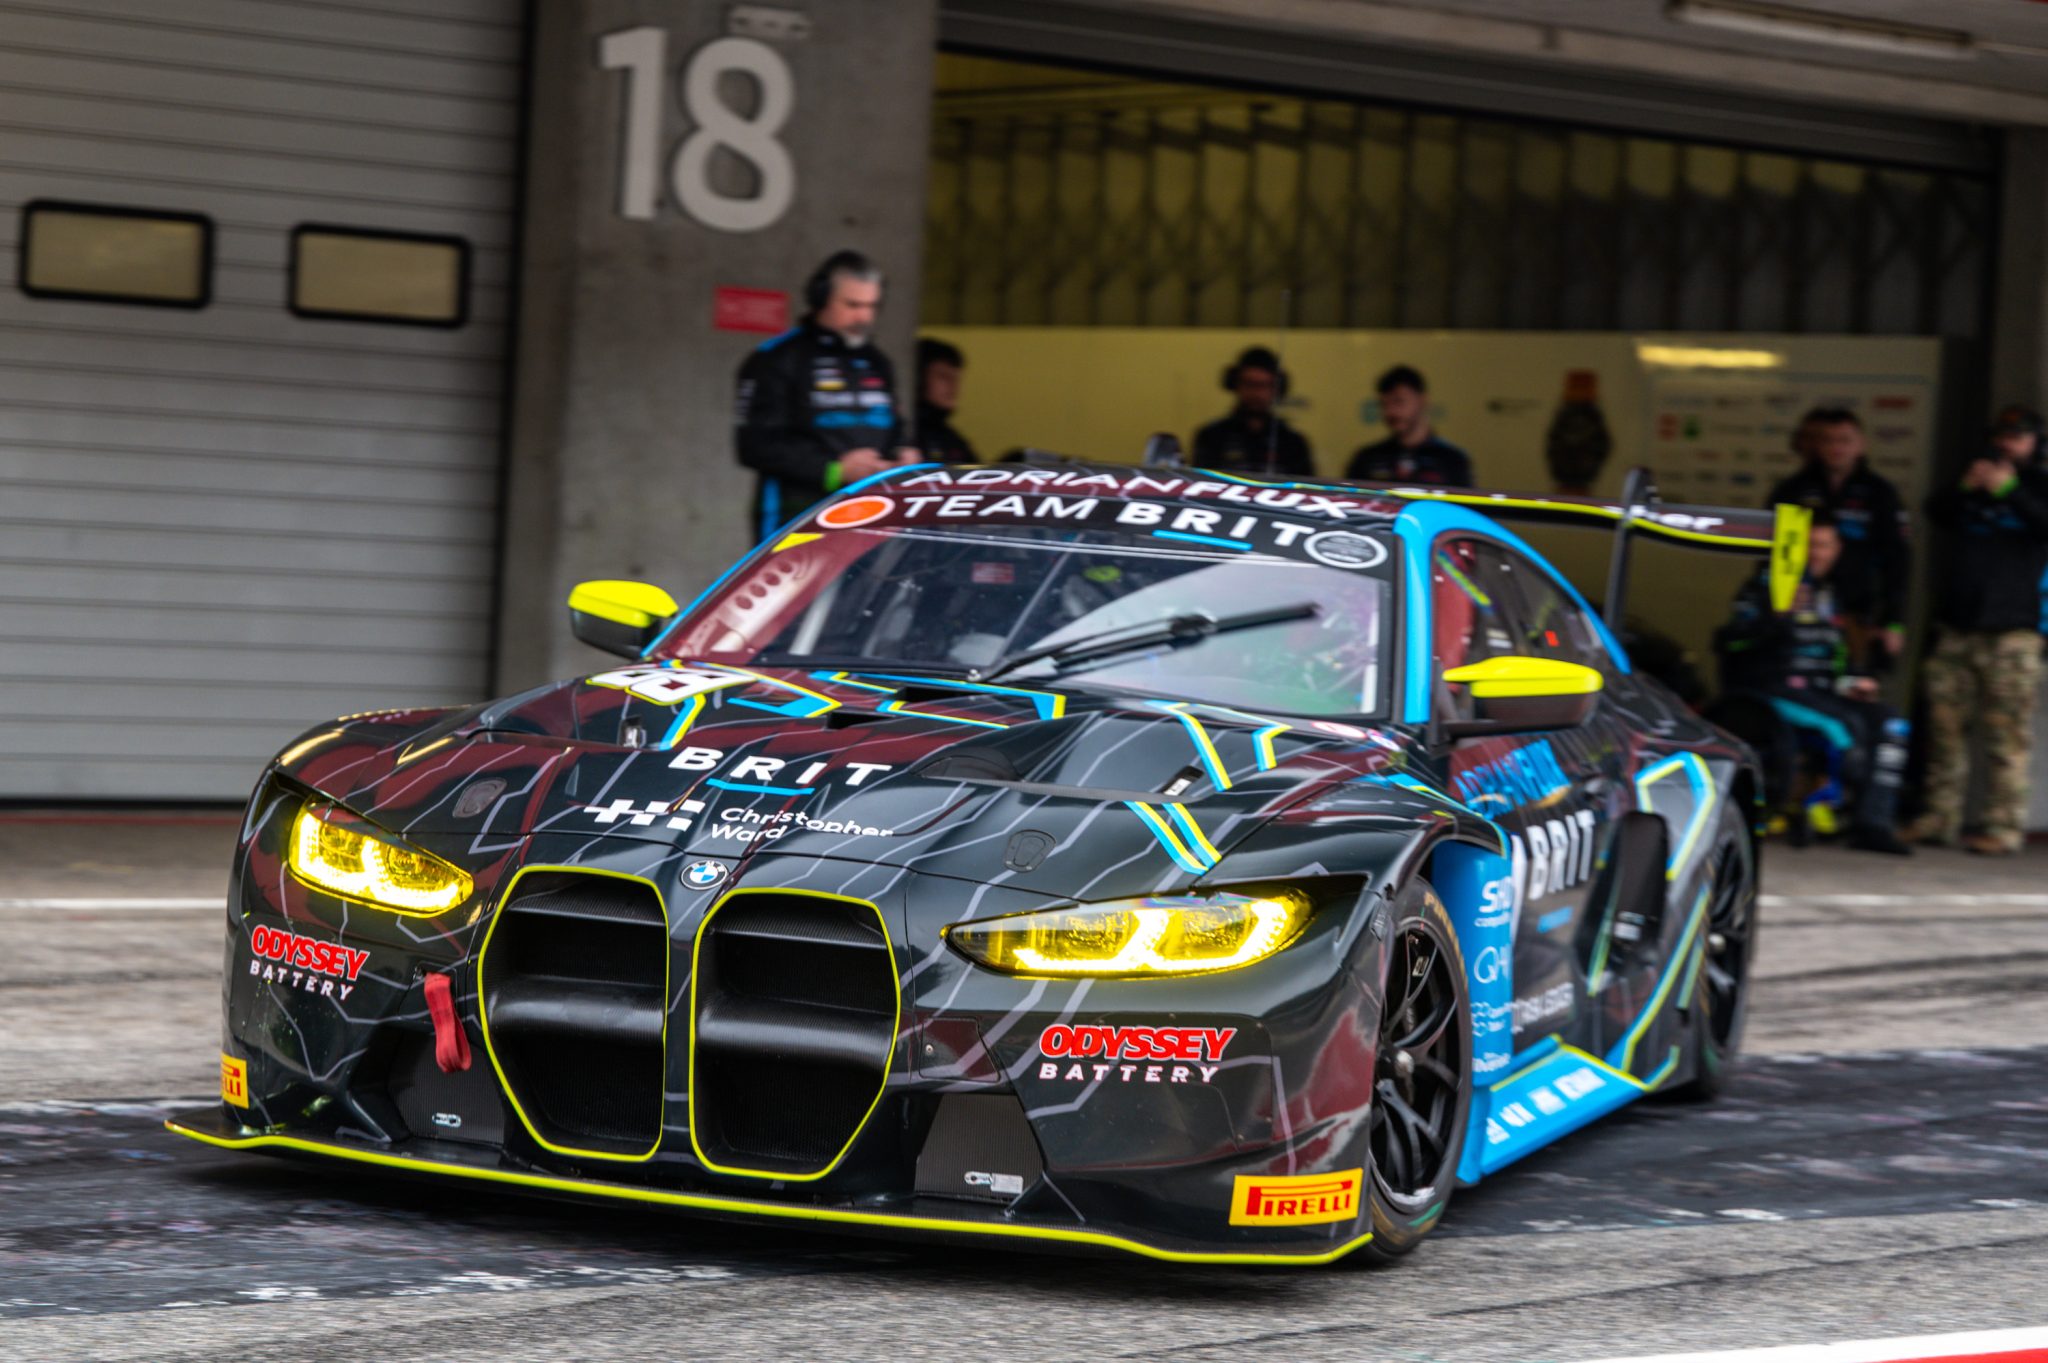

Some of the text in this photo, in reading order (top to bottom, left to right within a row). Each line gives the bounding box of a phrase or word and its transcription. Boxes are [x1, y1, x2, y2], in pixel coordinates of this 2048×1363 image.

[600, 25, 795, 232] 18
[903, 495, 1316, 547] TEAM BRIT
[668, 746, 893, 786] BRIT
[710, 823, 788, 842] Ward
[720, 807, 894, 837] Christopher
[1525, 809, 1596, 901] BRIT
[251, 924, 370, 982] ODYSSEY
[250, 959, 354, 1001] BATTERY
[1039, 1023, 1237, 1062] ODYSSEY
[1039, 1062, 1220, 1084] BATTERY
[1245, 1179, 1353, 1217] PIRELLI
